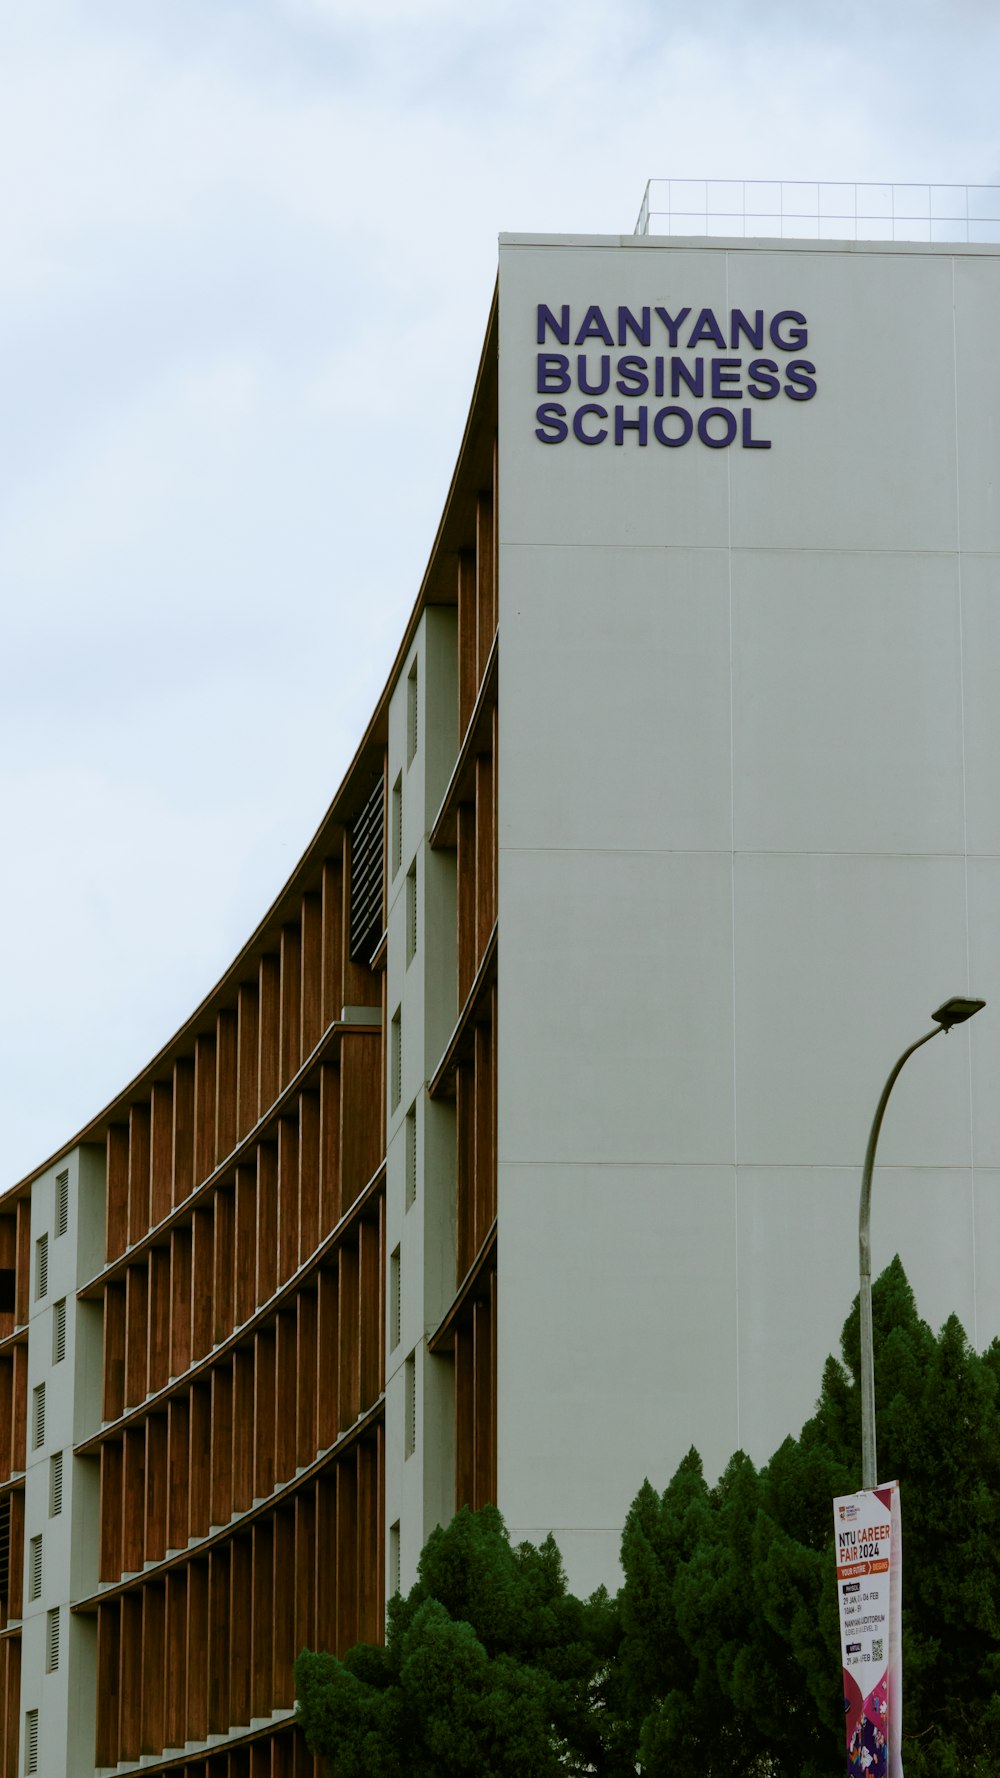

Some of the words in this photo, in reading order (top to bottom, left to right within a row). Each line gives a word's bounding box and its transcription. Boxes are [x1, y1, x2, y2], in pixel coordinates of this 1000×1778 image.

[537, 304, 808, 351] NANYANG
[537, 353, 817, 400] BUSINESS
[535, 402, 772, 449] SCHOOL
[839, 1531, 856, 1547] NTU
[858, 1525, 890, 1543] CAREER
[840, 1547, 858, 1563] FAIR
[859, 1542, 879, 1558] 2024
[841, 1567, 853, 1577] YOUR
[872, 1561, 888, 1571] BEGINS
[870, 1592, 879, 1600] FEB
[861, 1615, 885, 1624] UDITORIUM
